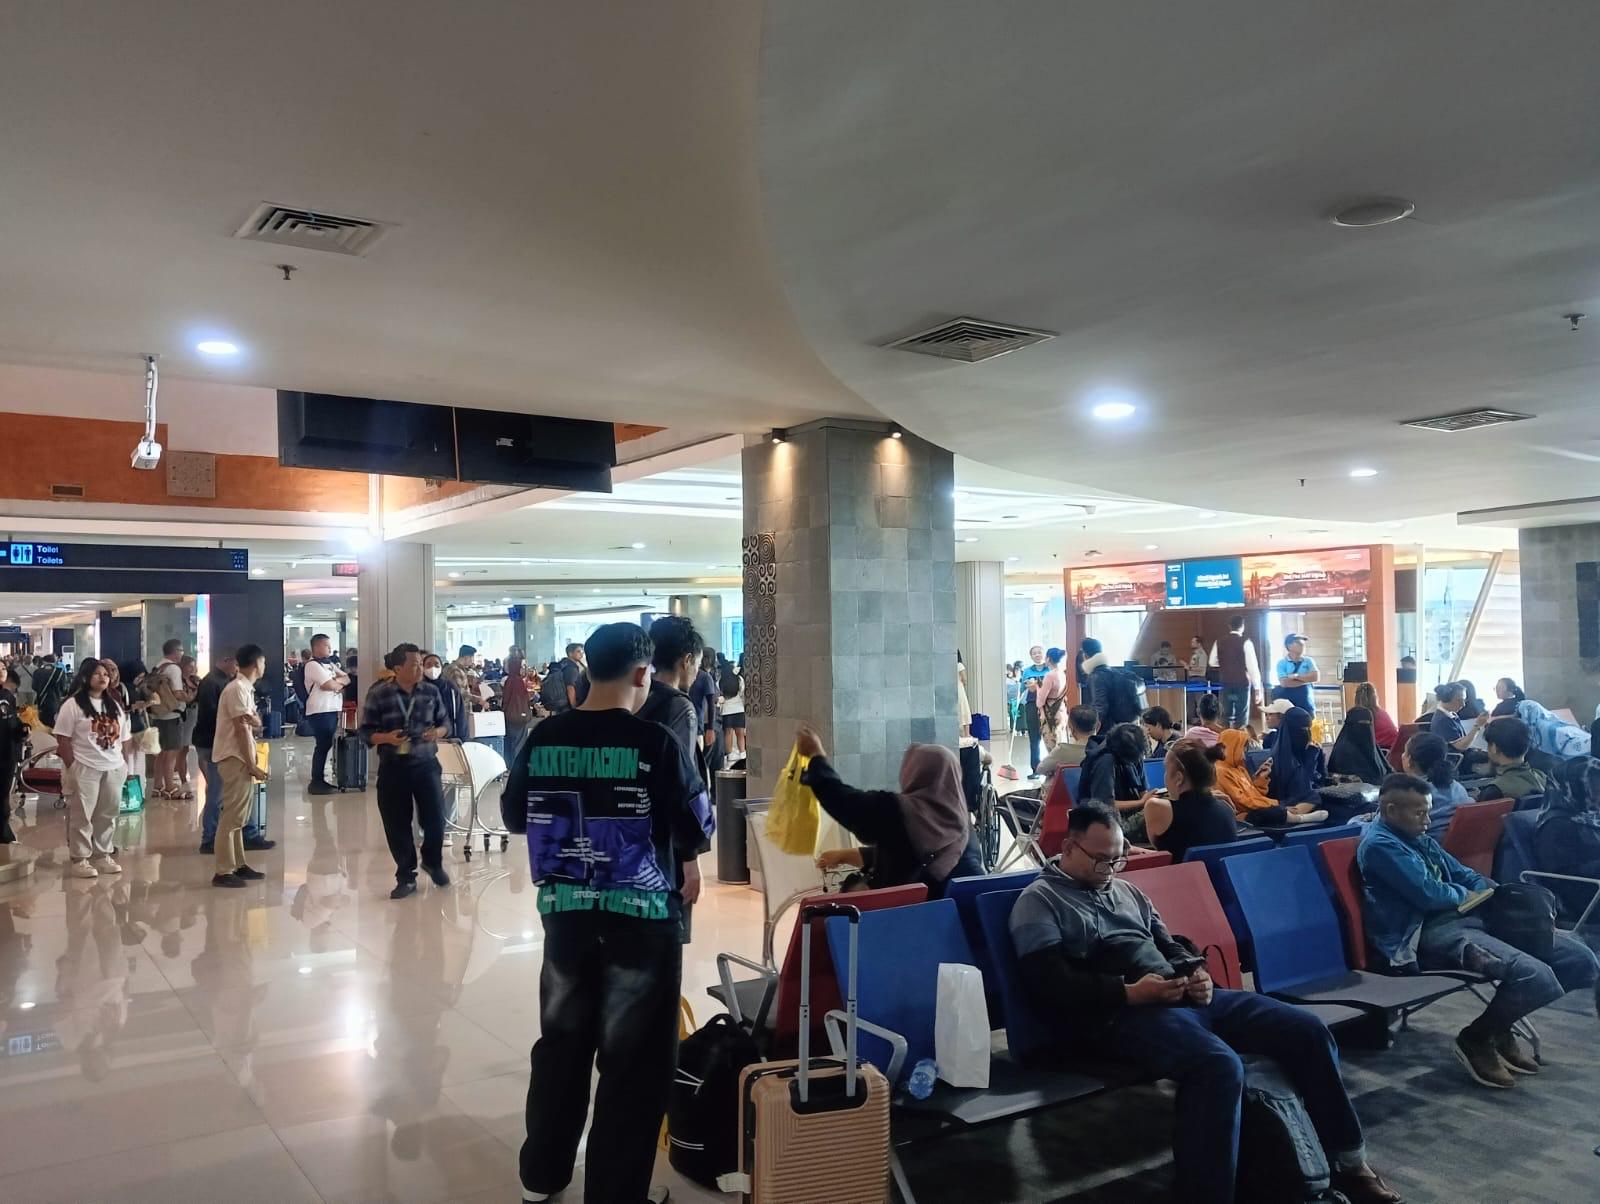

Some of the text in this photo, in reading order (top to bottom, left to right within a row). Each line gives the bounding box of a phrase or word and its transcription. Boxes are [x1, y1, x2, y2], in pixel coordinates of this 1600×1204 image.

[36, 545, 59, 553] Toilet
[36, 556, 63, 564] Toilets
[572, 890, 600, 899] STUDIO
